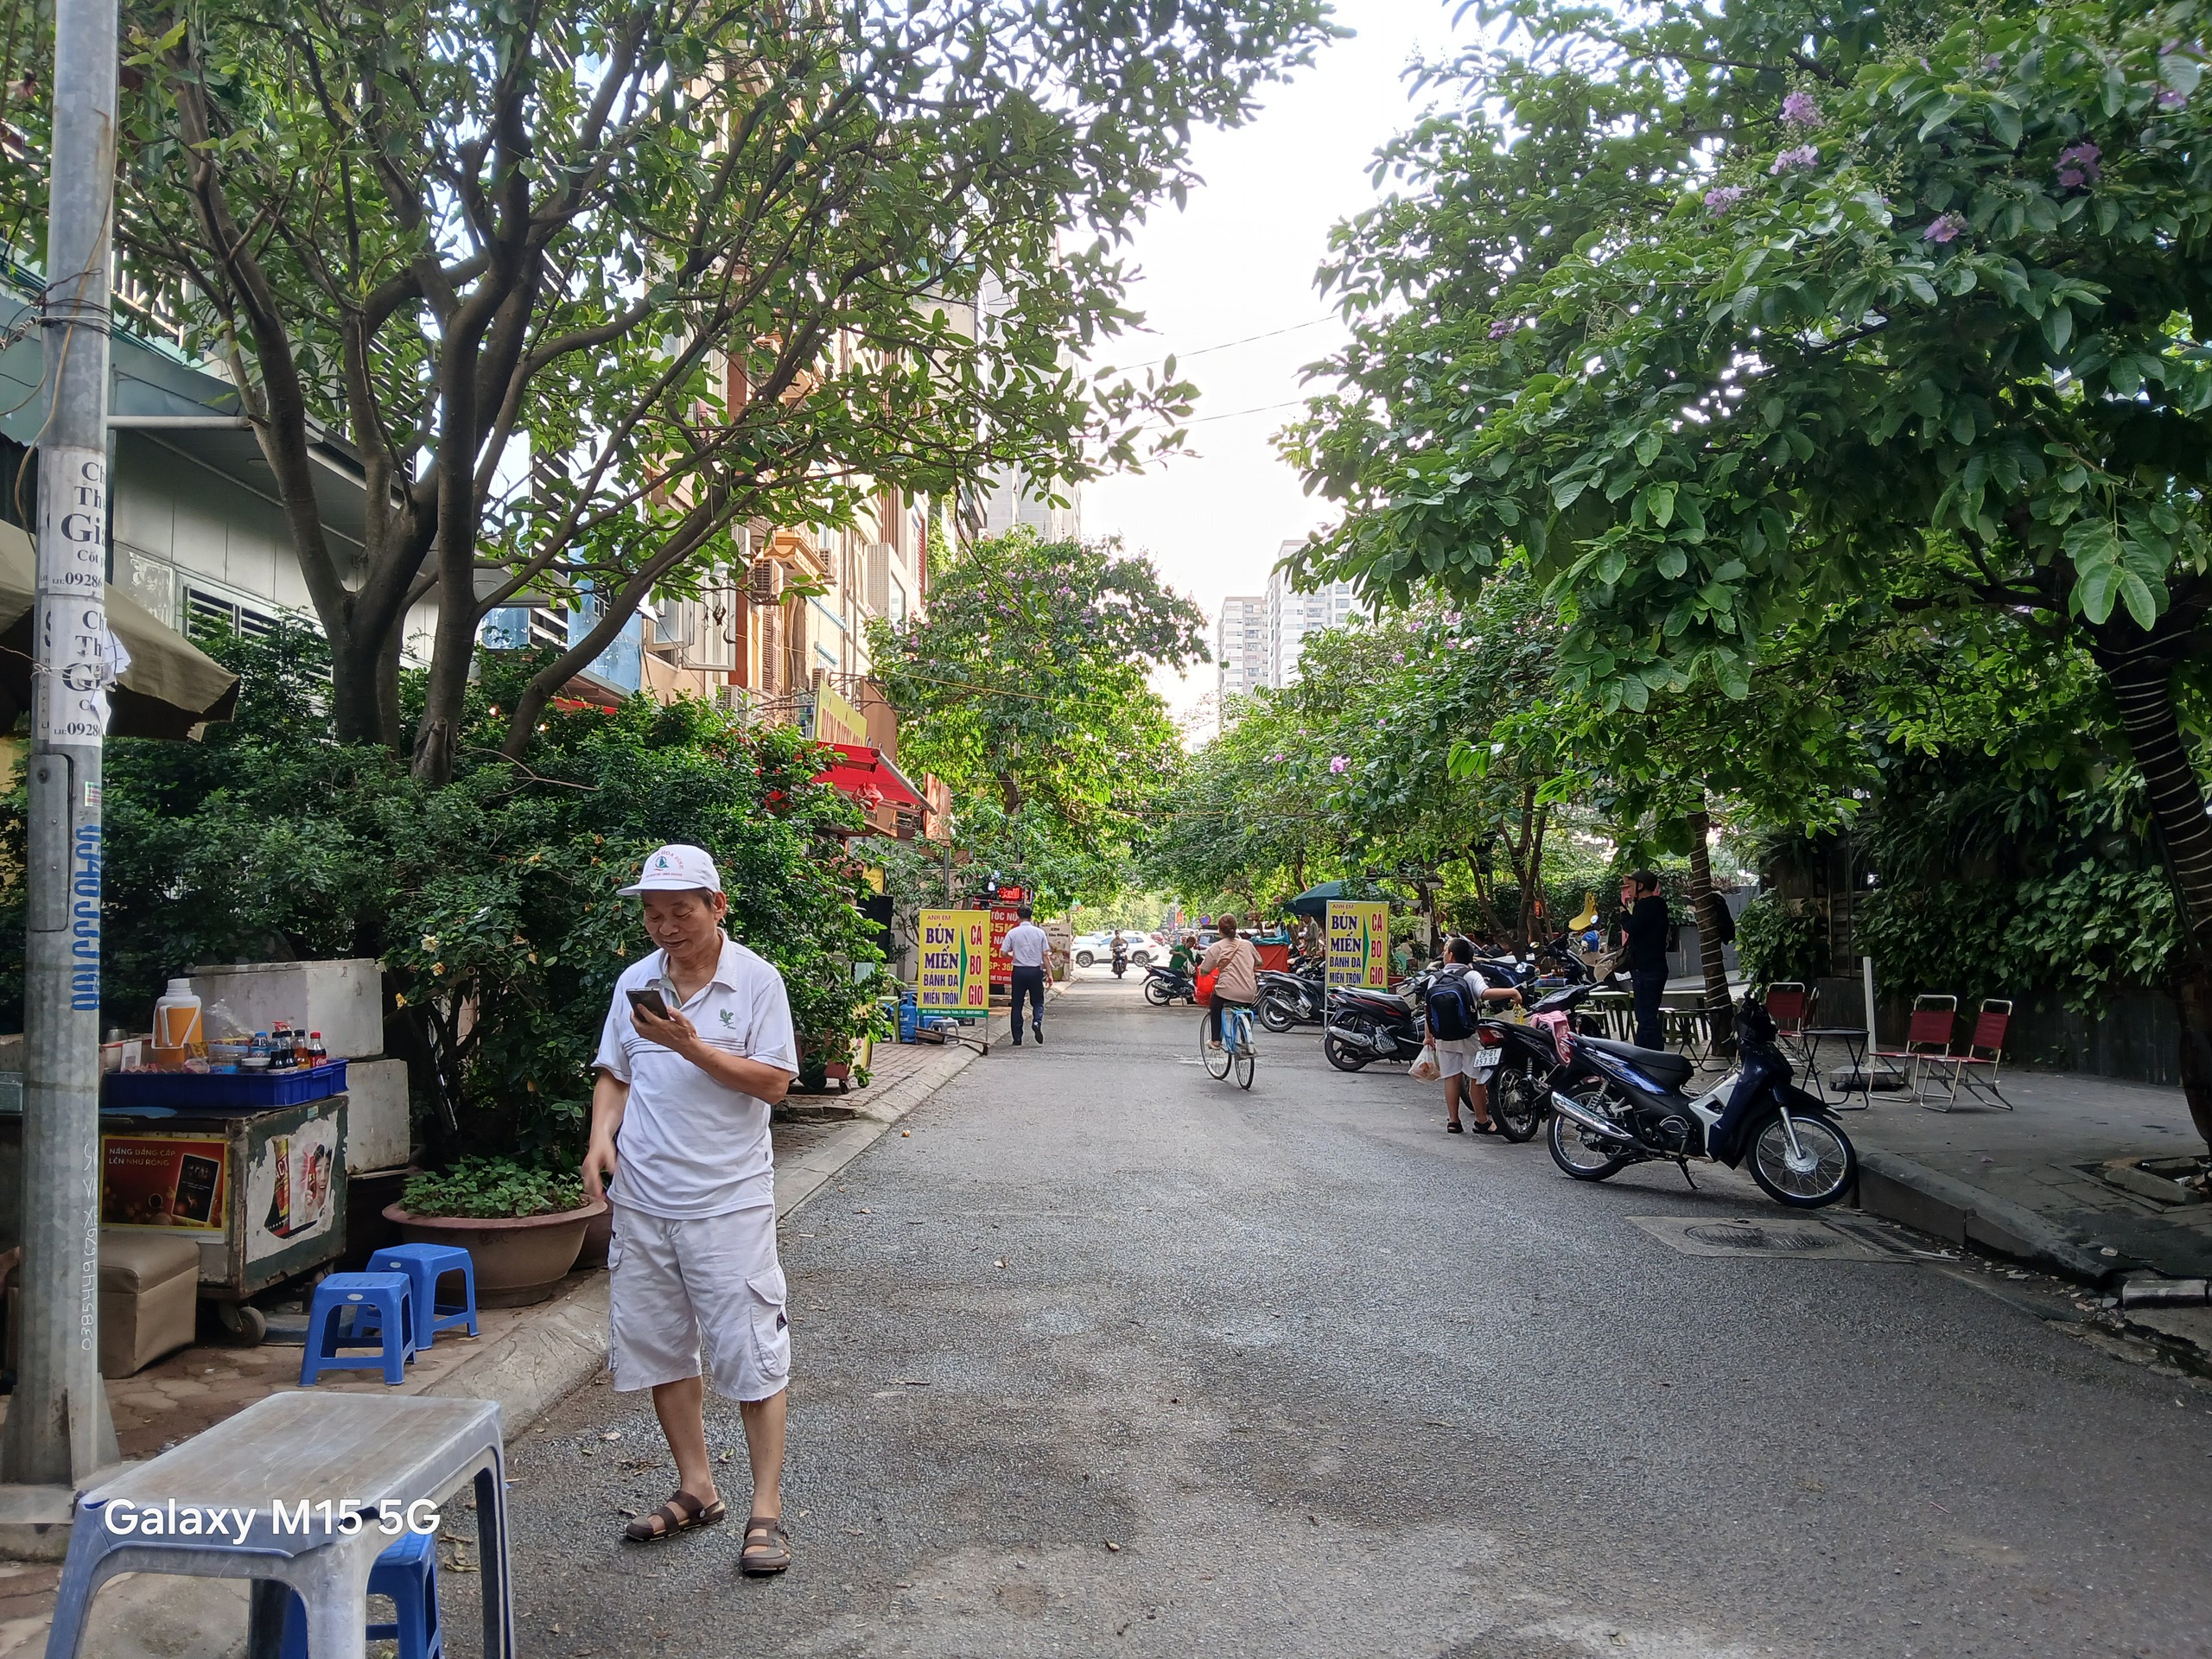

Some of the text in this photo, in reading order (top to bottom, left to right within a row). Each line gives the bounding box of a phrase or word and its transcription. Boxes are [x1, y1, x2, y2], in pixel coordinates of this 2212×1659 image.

[1332, 912, 1358, 930] BÚN
[1372, 910, 1382, 931] CÁ
[925, 923, 955, 944] BÚN
[970, 920, 982, 945] CÁ
[1331, 931, 1362, 952] MIẾN
[925, 944, 959, 969] MIẾN
[1371, 936, 1382, 958] BÒ
[969, 950, 982, 976] BÒ
[1330, 954, 1362, 968] BÁNH ĐA
[924, 970, 958, 987] BÁNH ĐA
[1329, 969, 1344, 983] MIẾN
[1370, 963, 1383, 985] GIÒ
[923, 988, 958, 1007] MIẾN TRỘN
[969, 980, 983, 1006] GIÒ
[81, 1227, 98, 1351] 0385449679
